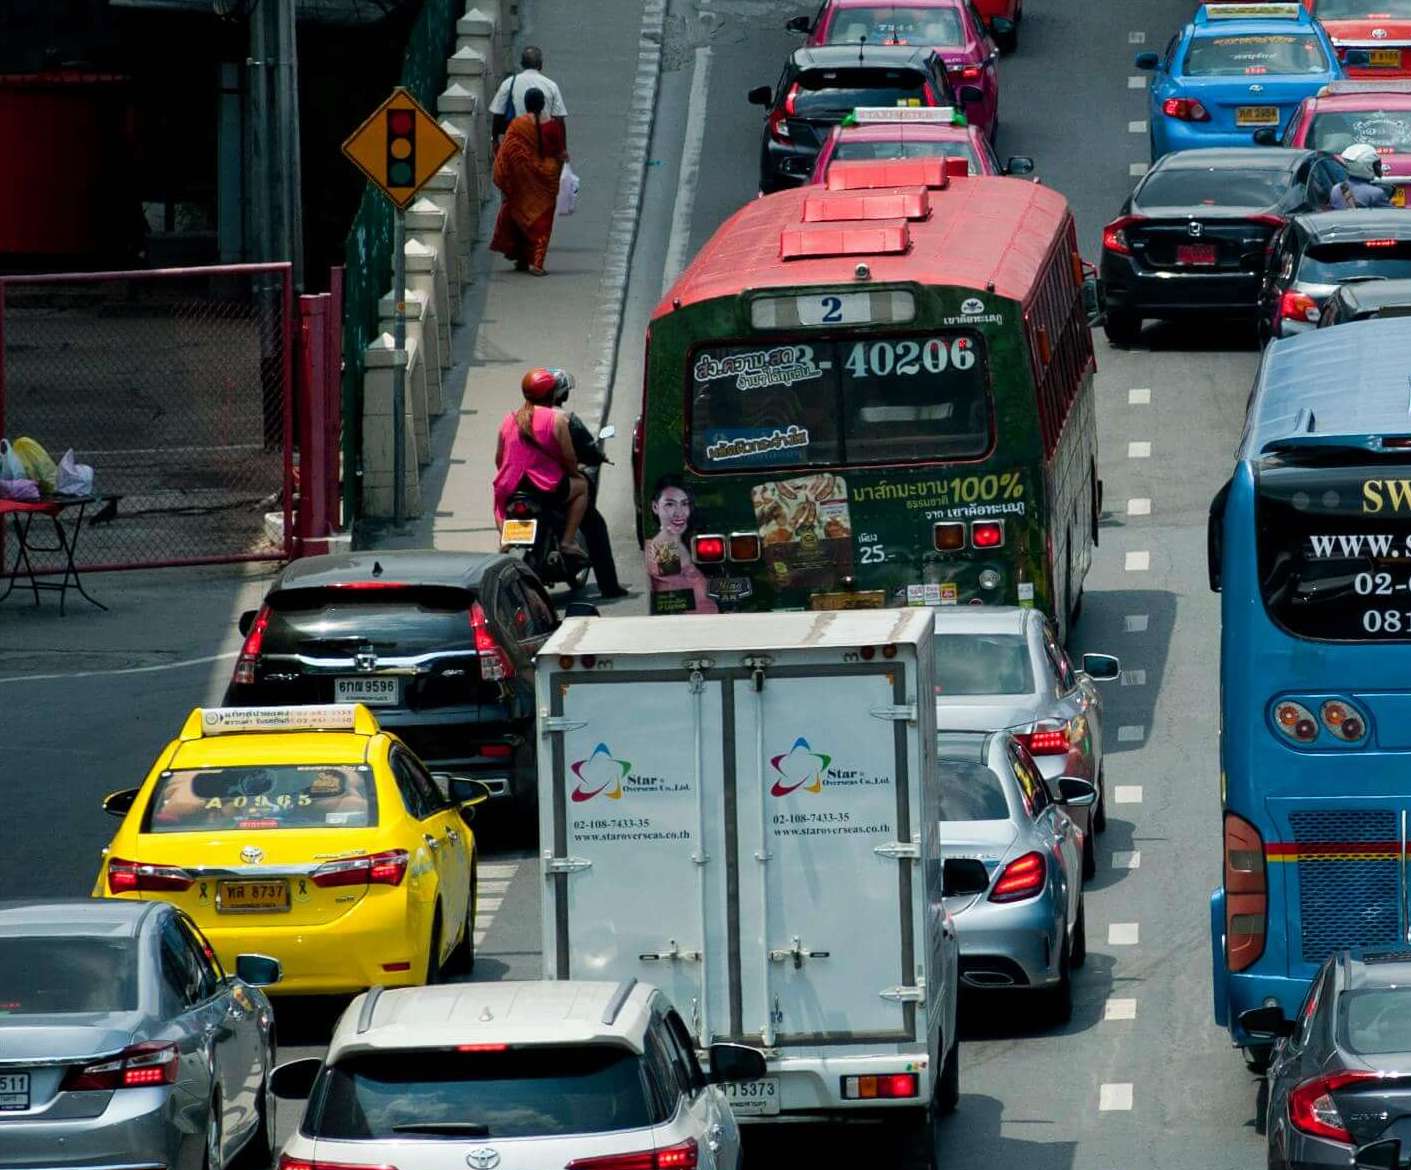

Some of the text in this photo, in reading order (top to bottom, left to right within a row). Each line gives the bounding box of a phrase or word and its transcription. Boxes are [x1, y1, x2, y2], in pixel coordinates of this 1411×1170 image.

[821, 297, 843, 323] 2
[950, 472, 1024, 503] 100%
[364, 680, 394, 693] 9596
[627, 775, 658, 786] Star
[827, 769, 858, 781] Star
[573, 818, 650, 829] 02-108-7433-35
[772, 812, 850, 824] 02-108-7433-35
[574, 830, 691, 842] www.staroverseas.co.th
[773, 824, 891, 837] www.staroverseas.co.th
[251, 885, 284, 899] 8737
[740, 1082, 776, 1097] 5373
